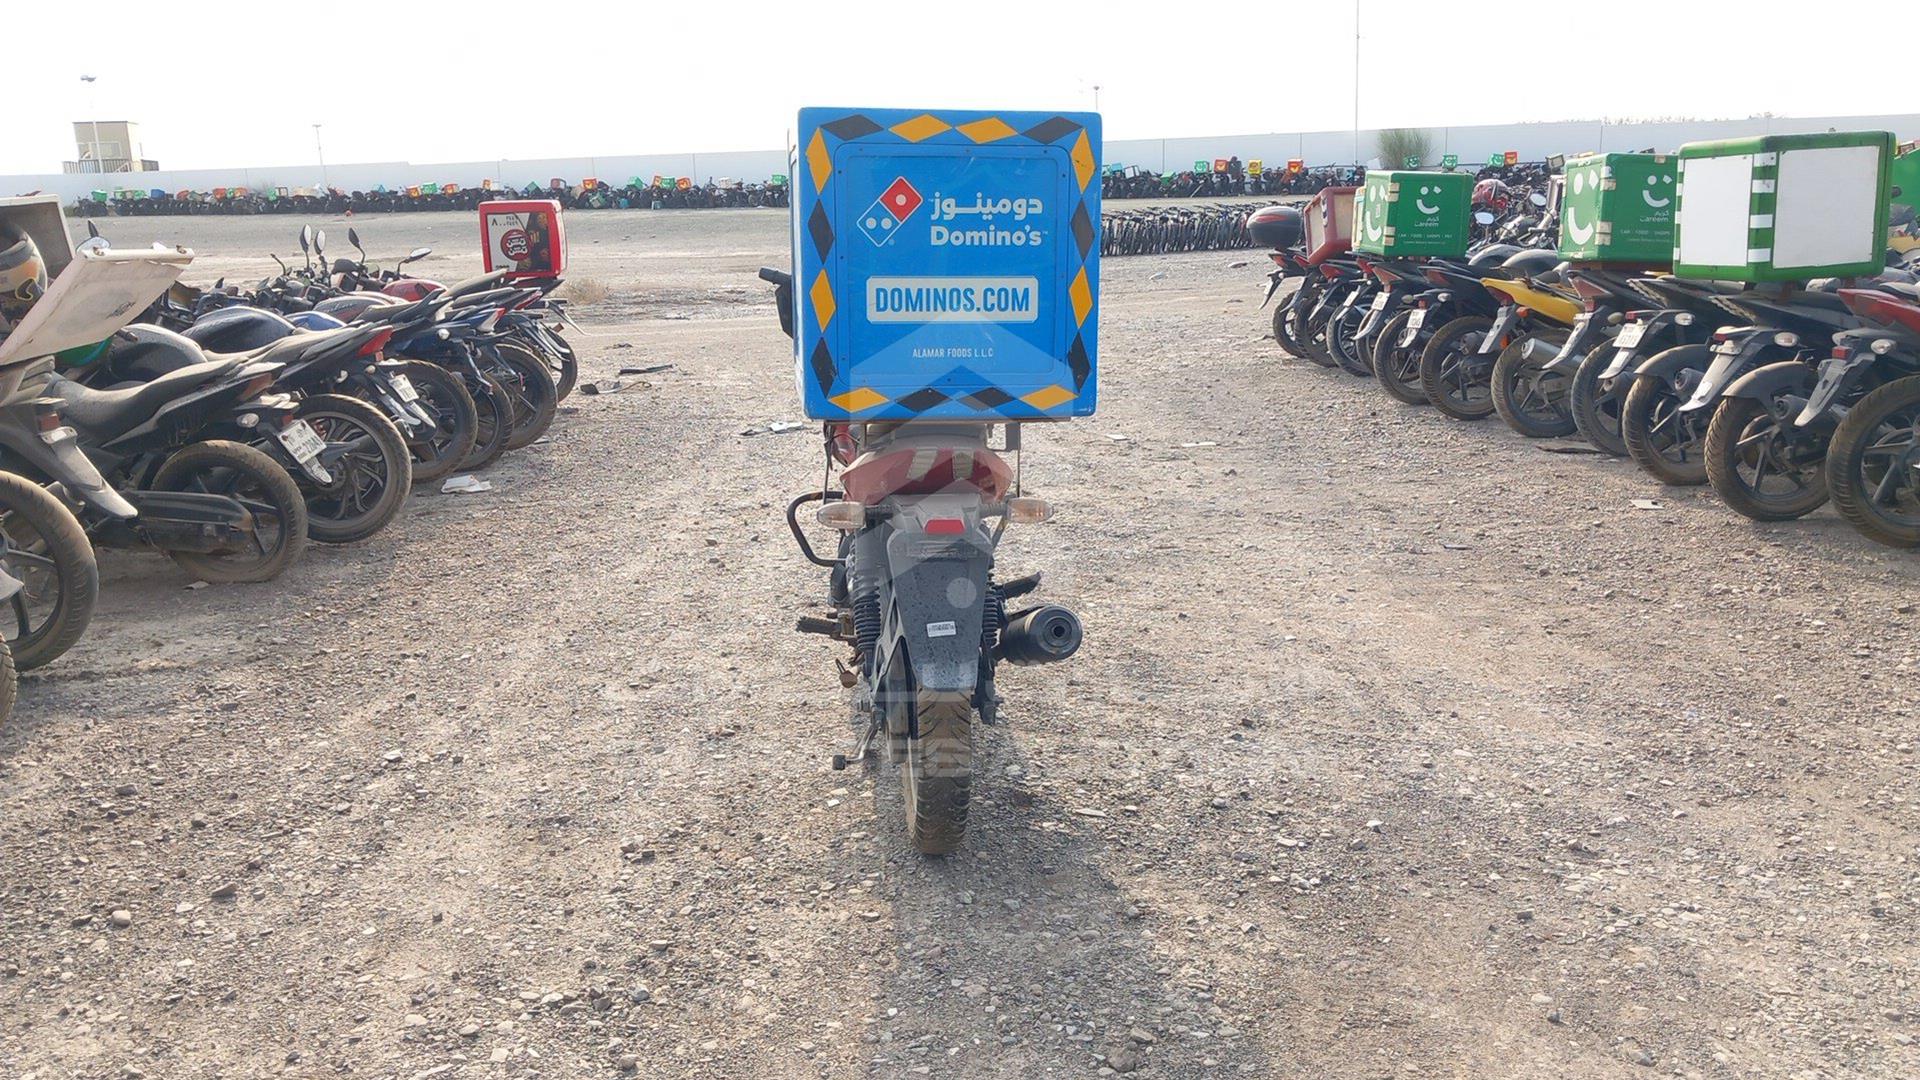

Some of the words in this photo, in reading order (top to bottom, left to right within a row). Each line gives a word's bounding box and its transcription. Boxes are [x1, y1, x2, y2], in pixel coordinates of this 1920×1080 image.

[931, 191, 1043, 221] دومينوز
[931, 225, 1042, 246] Domino's
[875, 287, 1030, 313] DOMINOS.COM
[912, 348, 945, 358] ALAMAR
[947, 348, 972, 358] FOODS
